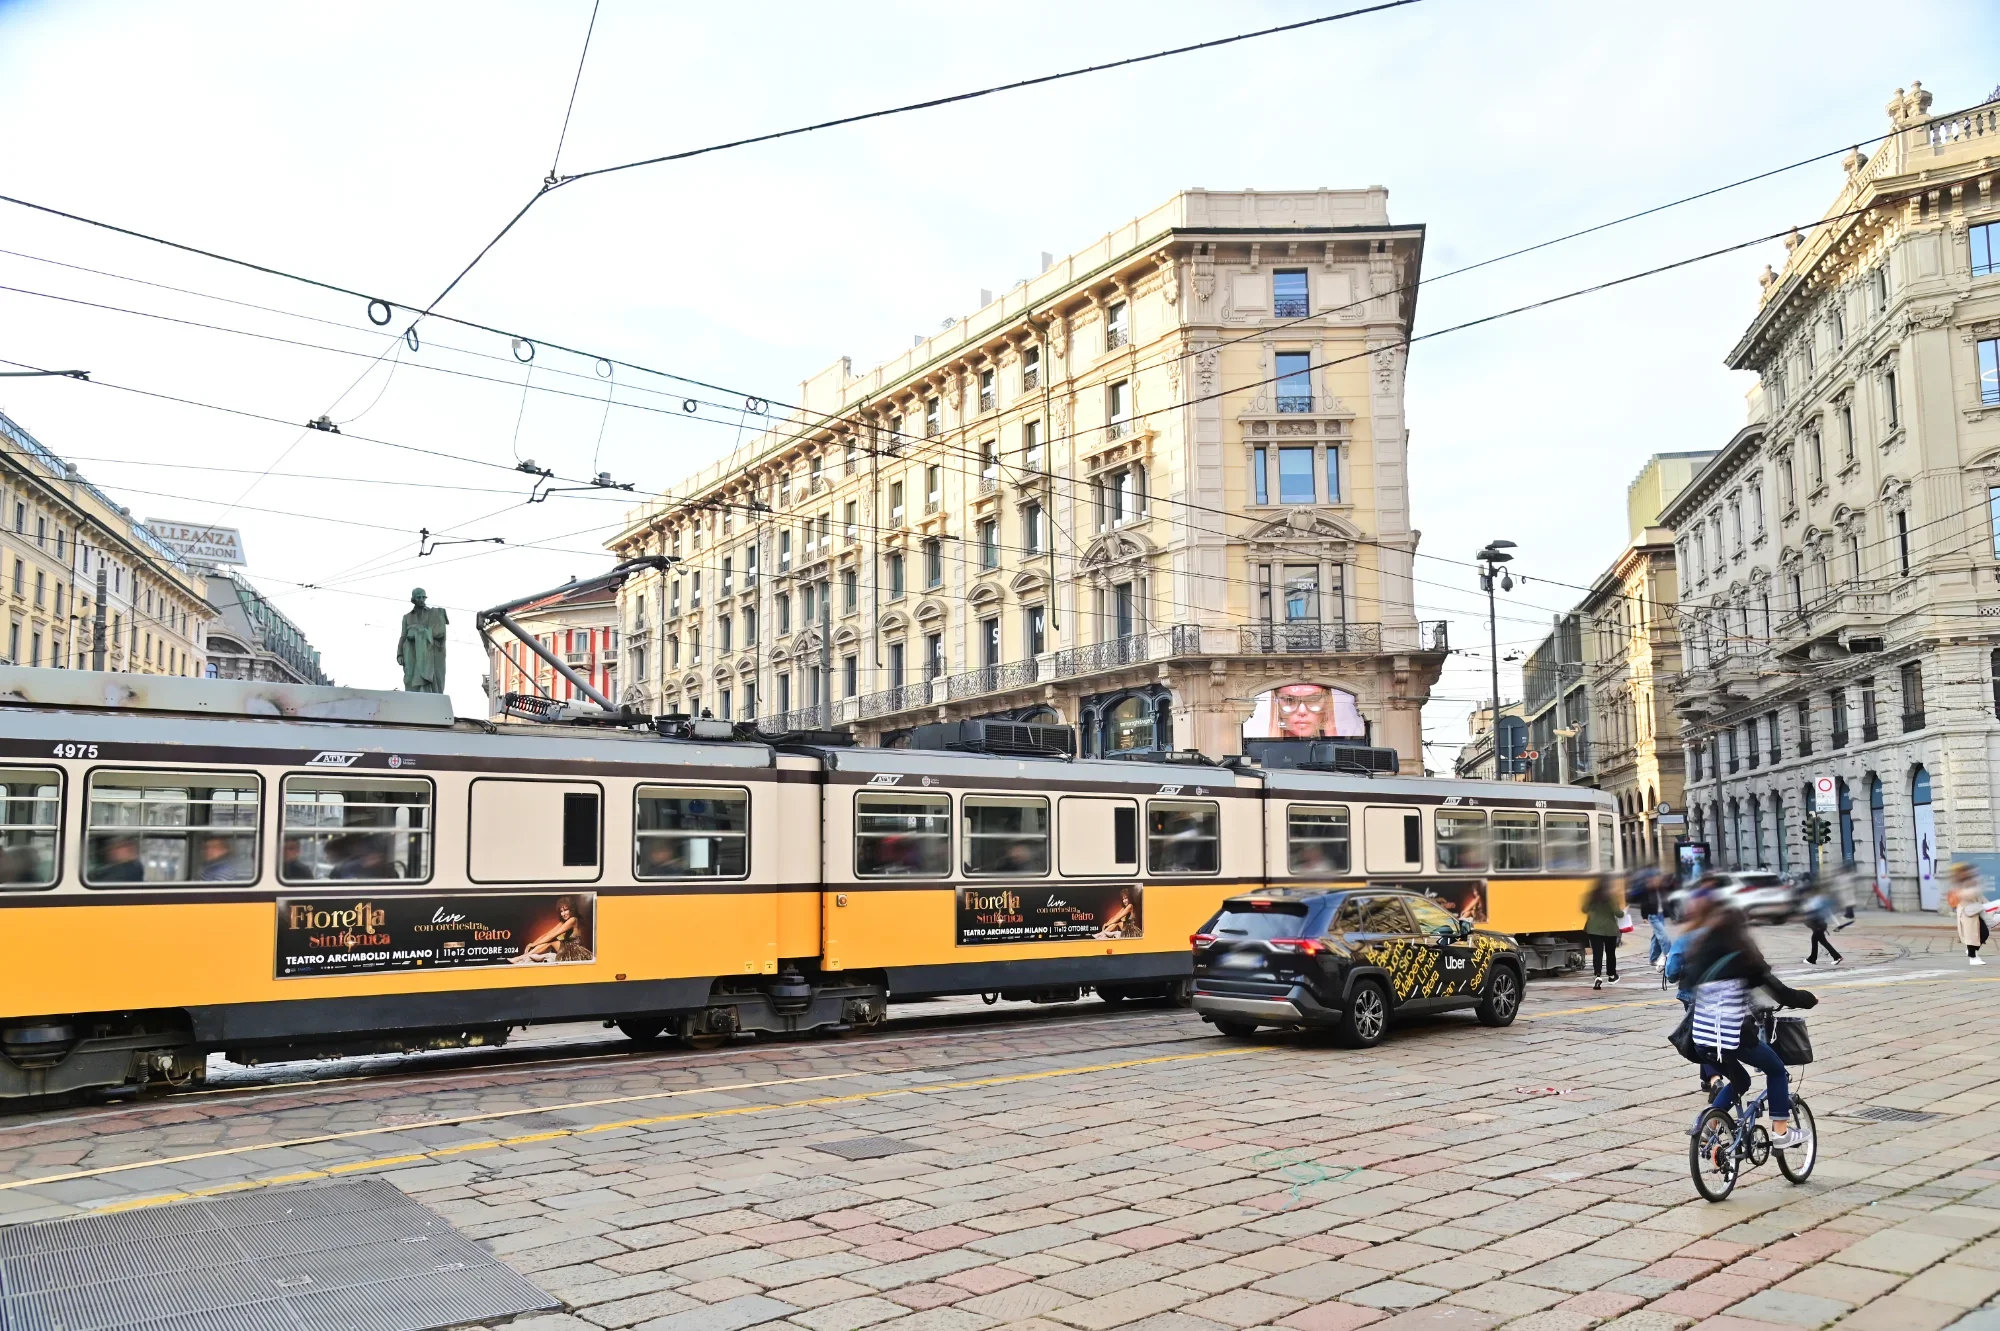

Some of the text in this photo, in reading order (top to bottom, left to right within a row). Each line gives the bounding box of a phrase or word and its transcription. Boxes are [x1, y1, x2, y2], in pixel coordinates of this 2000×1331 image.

[149, 524, 237, 547] ALLEANZA
[53, 743, 98, 758] 4975
[1535, 800, 1547, 809] 4975
[965, 890, 1021, 915] Fiorella
[1047, 894, 1067, 907] live
[288, 902, 385, 935] Fiorella
[432, 907, 466, 923] live
[1071, 912, 1094, 921] teatro
[436, 921, 483, 931] orchestra
[963, 926, 1049, 937] TEATRO ARCIMBOLDI MILANO
[474, 929, 511, 941] teatro
[286, 949, 433, 965] TEATRO ARCIMBOLDI MILANO
[467, 947, 502, 956] OTTOBRE
[1445, 956, 1466, 970] Uber
[1397, 946, 1427, 1002] Malpensa
[1421, 970, 1440, 999] Brera
